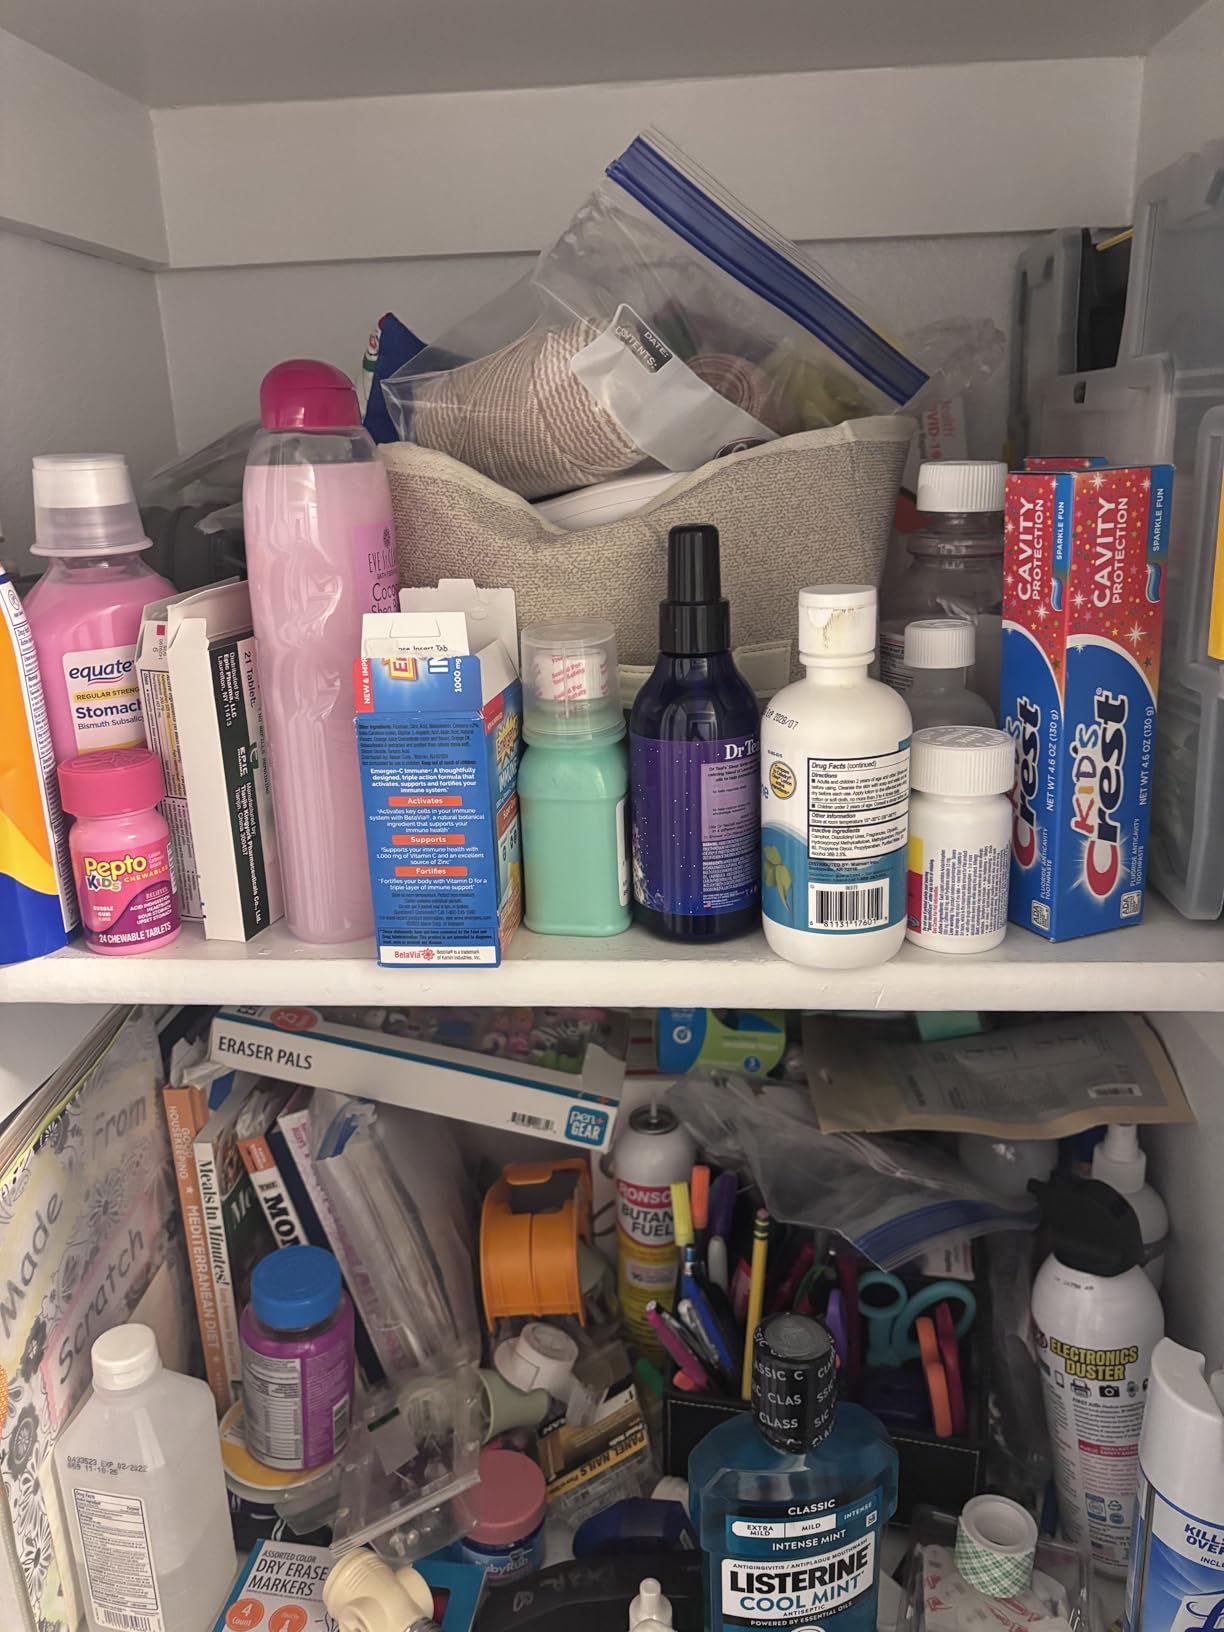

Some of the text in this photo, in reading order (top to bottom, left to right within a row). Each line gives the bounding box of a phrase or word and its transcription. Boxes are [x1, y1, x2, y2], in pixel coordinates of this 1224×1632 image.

[644, 331, 669, 357] DATE:
[1056, 501, 1065, 560] SPARKLE FUN
[1152, 488, 1164, 552] SPARKLE FUN
[1017, 496, 1034, 601] CAVITY
[1032, 499, 1044, 600] PROTECTION
[1093, 496, 1116, 608] CAVITY
[1112, 498, 1128, 604] PROTECTION
[244, 651, 251, 664] 21
[69, 660, 132, 682] equate
[230, 652, 238, 691] Distributed
[363, 678, 370, 686] &
[454, 658, 462, 692] 1000 mg
[76, 692, 111, 700] REGULAR
[773, 712, 799, 730] 2028/07
[1146, 706, 1154, 716] g)
[78, 721, 110, 730] Bismuth
[1049, 722, 1058, 741] (130
[1145, 718, 1153, 738] (130
[724, 743, 744, 760] Dr
[1050, 742, 1057, 756] OZ
[1144, 739, 1151, 751] OZ
[240, 747, 249, 775] EPIC
[812, 762, 827, 770] Drug
[847, 761, 876, 770] (continued)
[1048, 774, 1055, 791] WT
[1070, 728, 1099, 834] KID'S
[1140, 771, 1148, 786] WT
[1046, 792, 1054, 811] NET
[1086, 692, 1128, 896] Crest
[1139, 787, 1148, 805] NET
[1041, 828, 1049, 862] ANTICAVITY
[1132, 818, 1140, 854] ANTICAVITY
[84, 854, 147, 881] Pepto
[124, 865, 169, 883] CHEWABLES
[248, 840, 258, 896] Pharmaceuticals
[1135, 845, 1144, 885] TOOTHPASTE
[1122, 896, 1130, 915] ADA
[136, 917, 152, 925] UPSET
[99, 922, 172, 943] 24 CHEWABLE TABLETS
[218, 1036, 312, 1070] ERASER PALS
[571, 1121, 600, 1140] GEAR
[168, 1106, 188, 1179] HOUSEKEEPING
[199, 1160, 217, 1204] Meals
[205, 1205, 218, 1220] In
[632, 1222, 674, 1237] FUEL
[208, 1223, 230, 1286] Minutes!
[0, 1192, 63, 1340] Made
[186, 1205, 220, 1349] MEDITERRANEAN DIET
[59, 1228, 144, 1384] Scratch
[1050, 1336, 1139, 1366] ELECTRONICS
[1065, 1360, 1126, 1380] DUSTER
[768, 1392, 802, 1406] CLAS
[759, 1411, 798, 1429] CLASS
[616, 1430, 645, 1456] PANEL
[580, 1450, 610, 1477] NAILS
[788, 1499, 836, 1515] CLASSIC
[802, 1523, 821, 1532] MILD
[844, 1502, 872, 1520] INTENSE
[772, 1529, 846, 1551] INTENSE MINT
[263, 1550, 316, 1563] ASSORTED COLOR
[733, 1538, 868, 1571] ANTIGINGIVITIS ANTIPLAQUE MOUTHWASH
[256, 1558, 329, 1581] DRY ERASE
[730, 1546, 869, 1594] LISTERINE
[248, 1574, 315, 1596] MARKERS
[740, 1575, 860, 1612] COOL MINT
[242, 1603, 253, 1616] 4
[783, 1604, 825, 1617] ANTISEPTIC
[800, 1609, 836, 1623] ESSENTIAL
[838, 1602, 852, 1612] OILS
